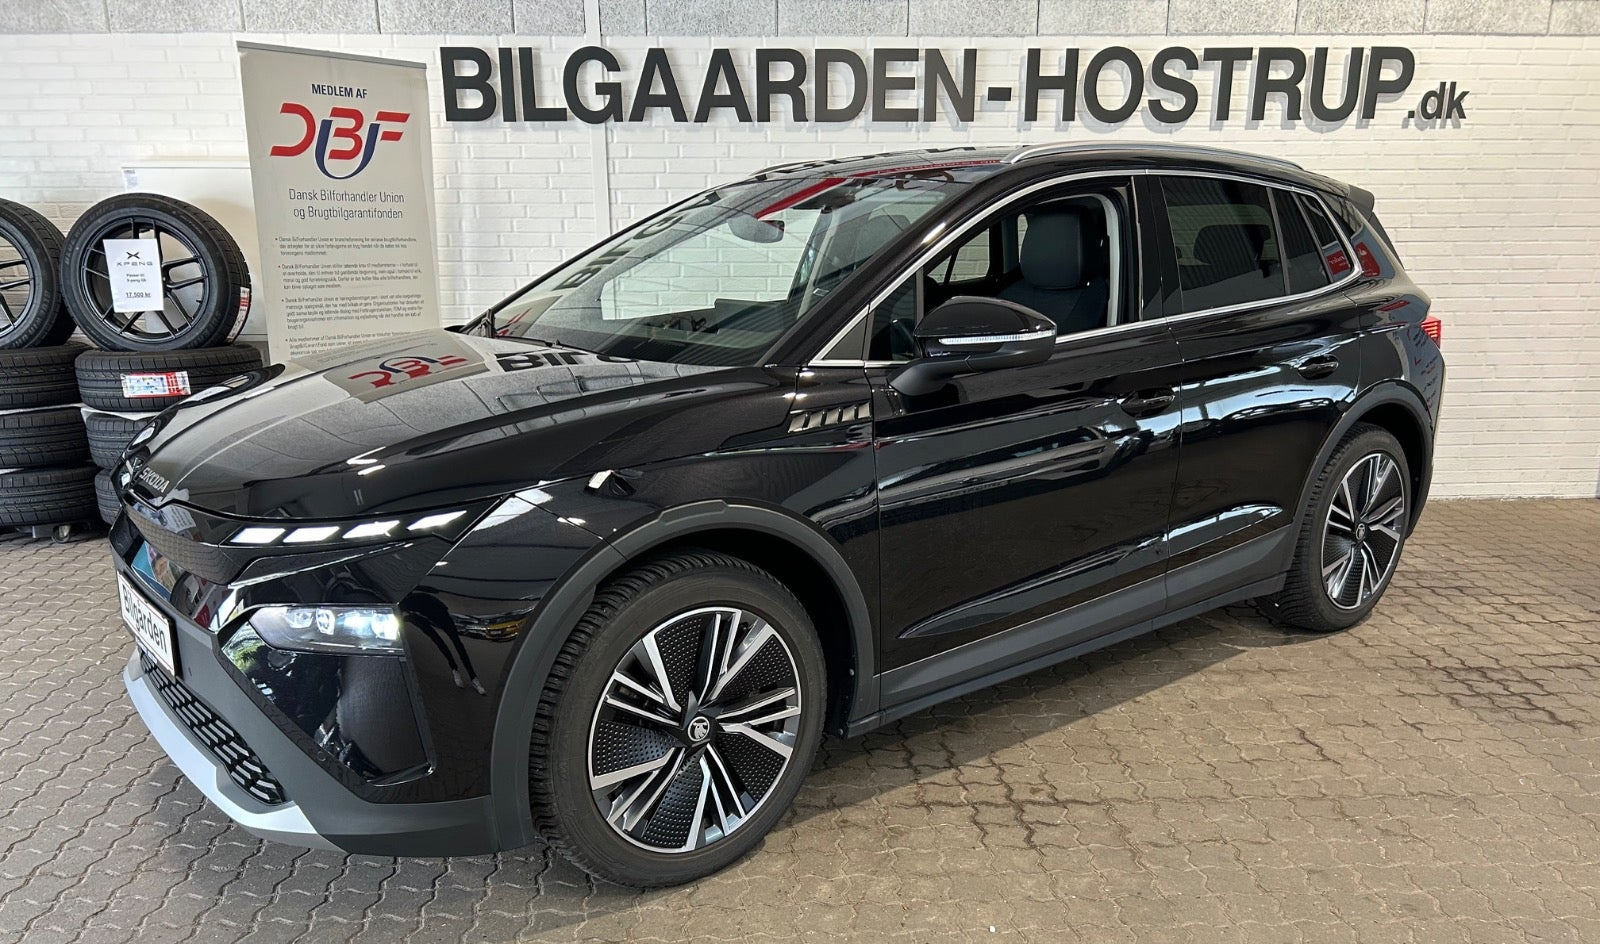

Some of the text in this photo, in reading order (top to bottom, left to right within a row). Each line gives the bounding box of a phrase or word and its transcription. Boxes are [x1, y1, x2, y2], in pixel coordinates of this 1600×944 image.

[311, 83, 368, 99] MEDLEM AF
[289, 188, 405, 203] Dansk Bilforhandler Union
[293, 205, 403, 220] og Brugtbilgarantifonden
